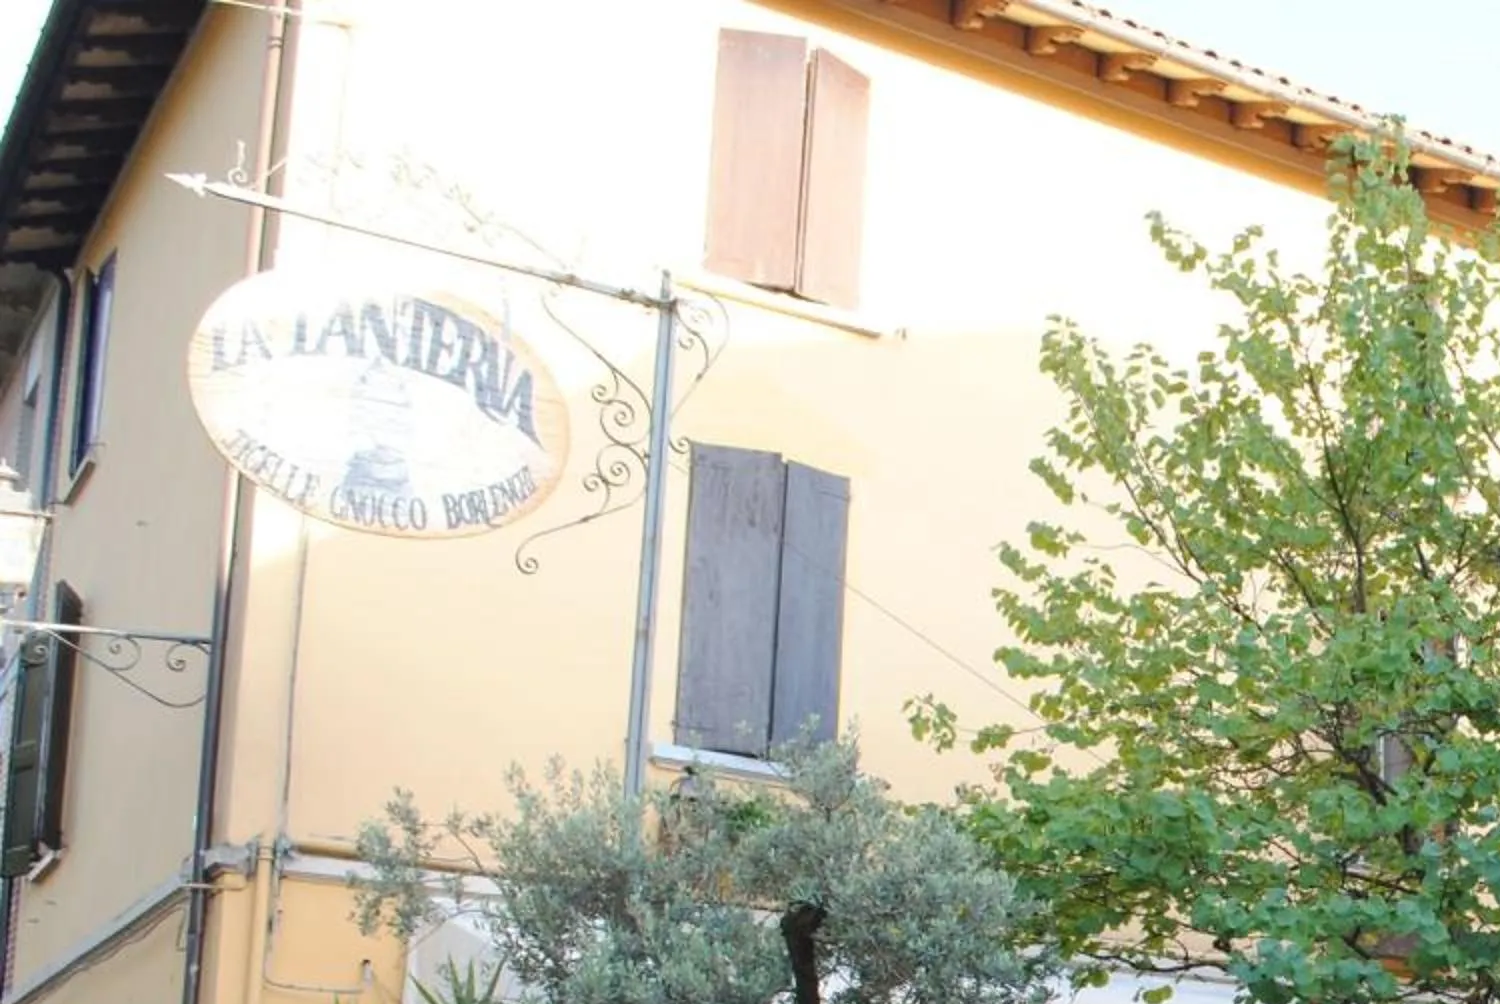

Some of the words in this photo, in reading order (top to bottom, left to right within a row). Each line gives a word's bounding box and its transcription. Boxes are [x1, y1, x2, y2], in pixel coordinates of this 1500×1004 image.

[211, 317, 273, 371] LA
[287, 294, 548, 452] LANTERNA
[329, 485, 428, 531] GNOCCO
